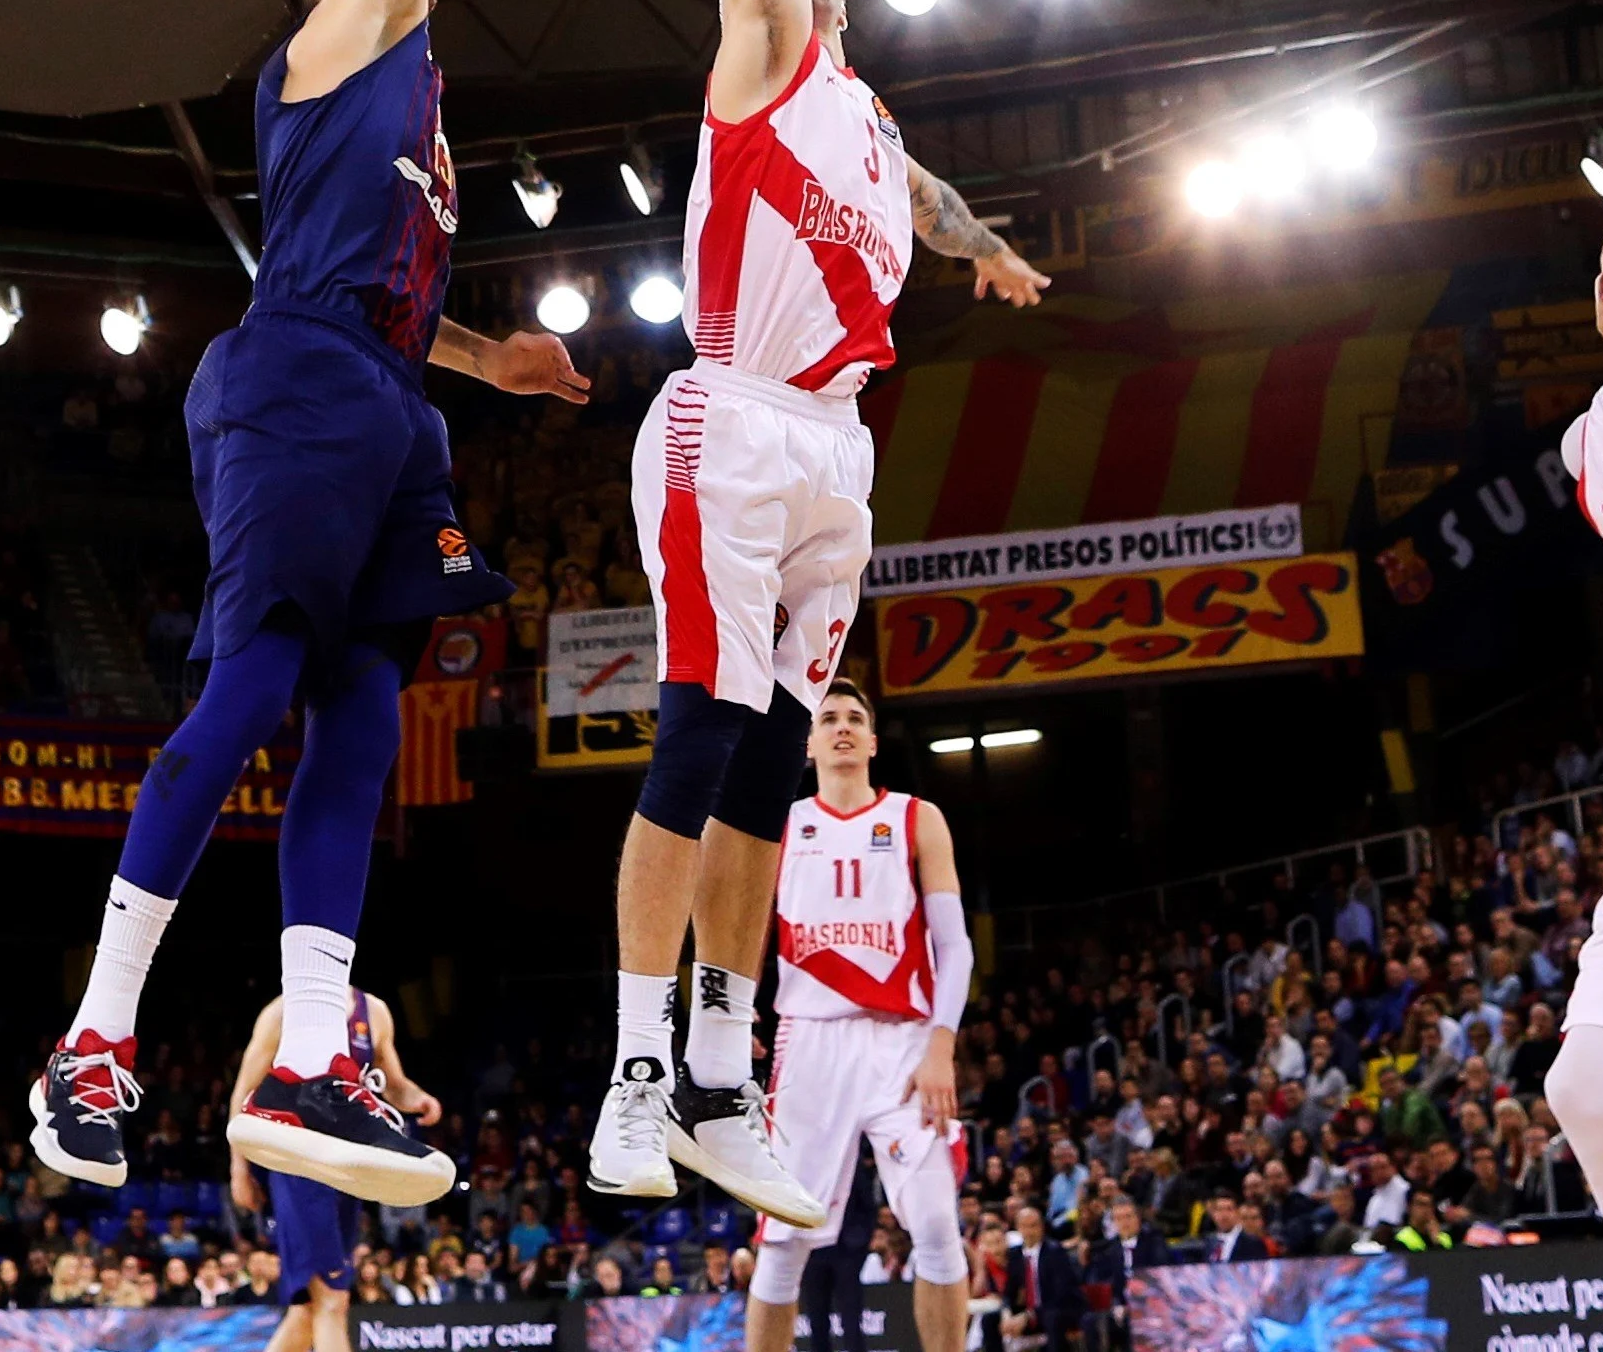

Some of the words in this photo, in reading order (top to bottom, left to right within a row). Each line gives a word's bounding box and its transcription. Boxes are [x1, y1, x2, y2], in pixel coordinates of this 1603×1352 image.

[867, 548, 1004, 588] LLIBERTAT
[1008, 535, 1114, 574] PRESOS
[1121, 519, 1255, 563] POLÍTICS!
[883, 560, 1349, 688] DRACS
[832, 859, 862, 899] 11
[1479, 1273, 1571, 1316] Nascut
[359, 1320, 446, 1350] Nascut
[450, 1324, 494, 1352] per
[495, 1321, 558, 1346] estar
